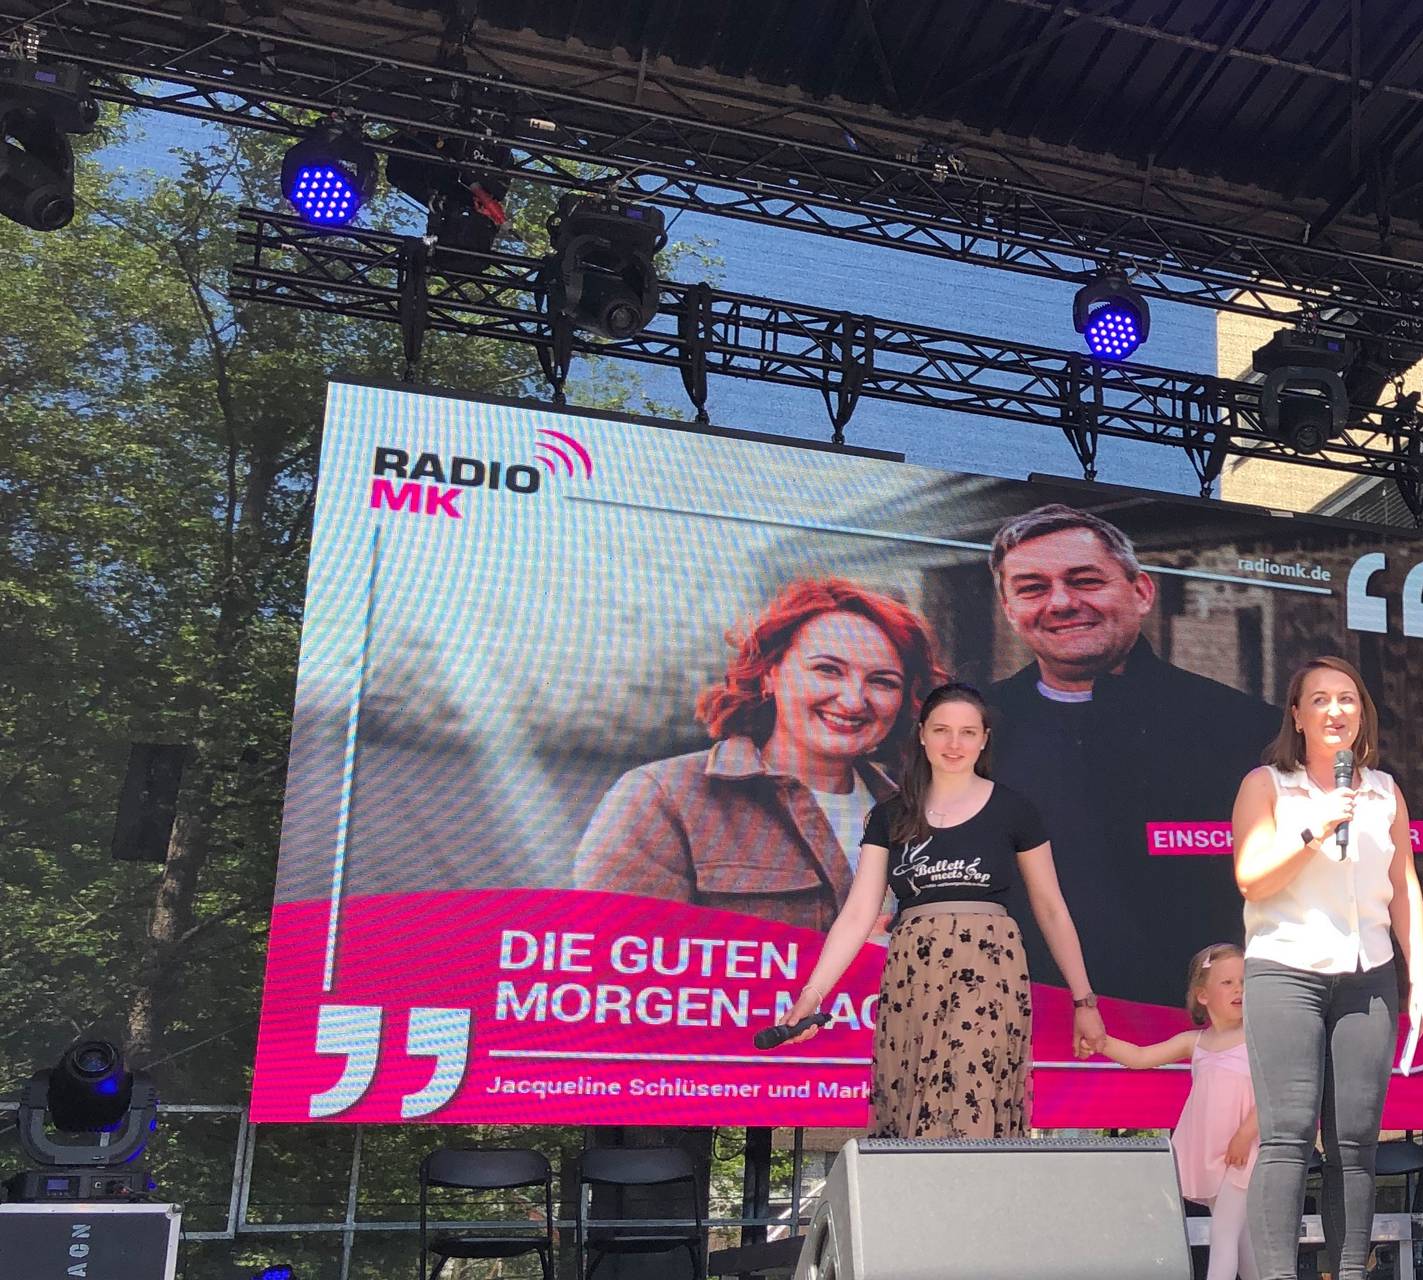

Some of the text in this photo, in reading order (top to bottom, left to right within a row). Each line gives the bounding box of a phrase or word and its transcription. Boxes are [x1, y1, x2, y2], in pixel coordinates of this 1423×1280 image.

[373, 446, 541, 494] RADIO
[370, 478, 464, 519] MK
[1237, 558, 1332, 582] radiomk.de
[914, 858, 966, 878] Ballett
[930, 869, 963, 882] meets
[499, 929, 800, 980] DIE GUTEN
[486, 1076, 622, 1100] Jacqueline
[629, 1078, 761, 1098] Schlüsener
[768, 1080, 811, 1098] und
[67, 1223, 92, 1278] ACN
